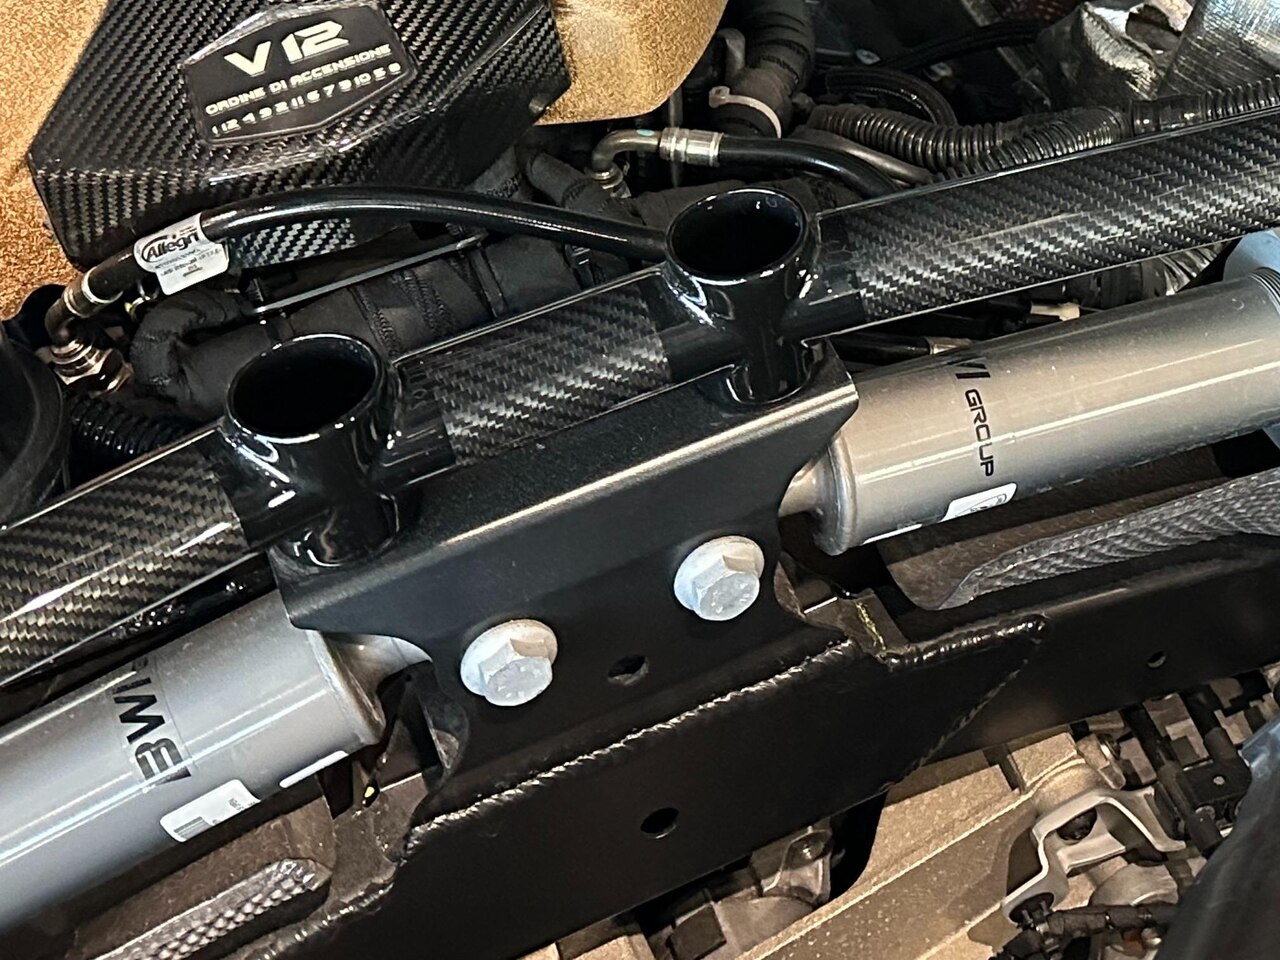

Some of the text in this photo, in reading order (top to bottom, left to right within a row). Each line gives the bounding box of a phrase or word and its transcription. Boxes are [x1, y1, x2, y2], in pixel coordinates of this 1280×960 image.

[205, 43, 392, 117] ORDINE DI ACCENSIONE
[224, 20, 350, 77] V12
[322, 84, 335, 97] 7
[964, 389, 994, 477] GROUP
